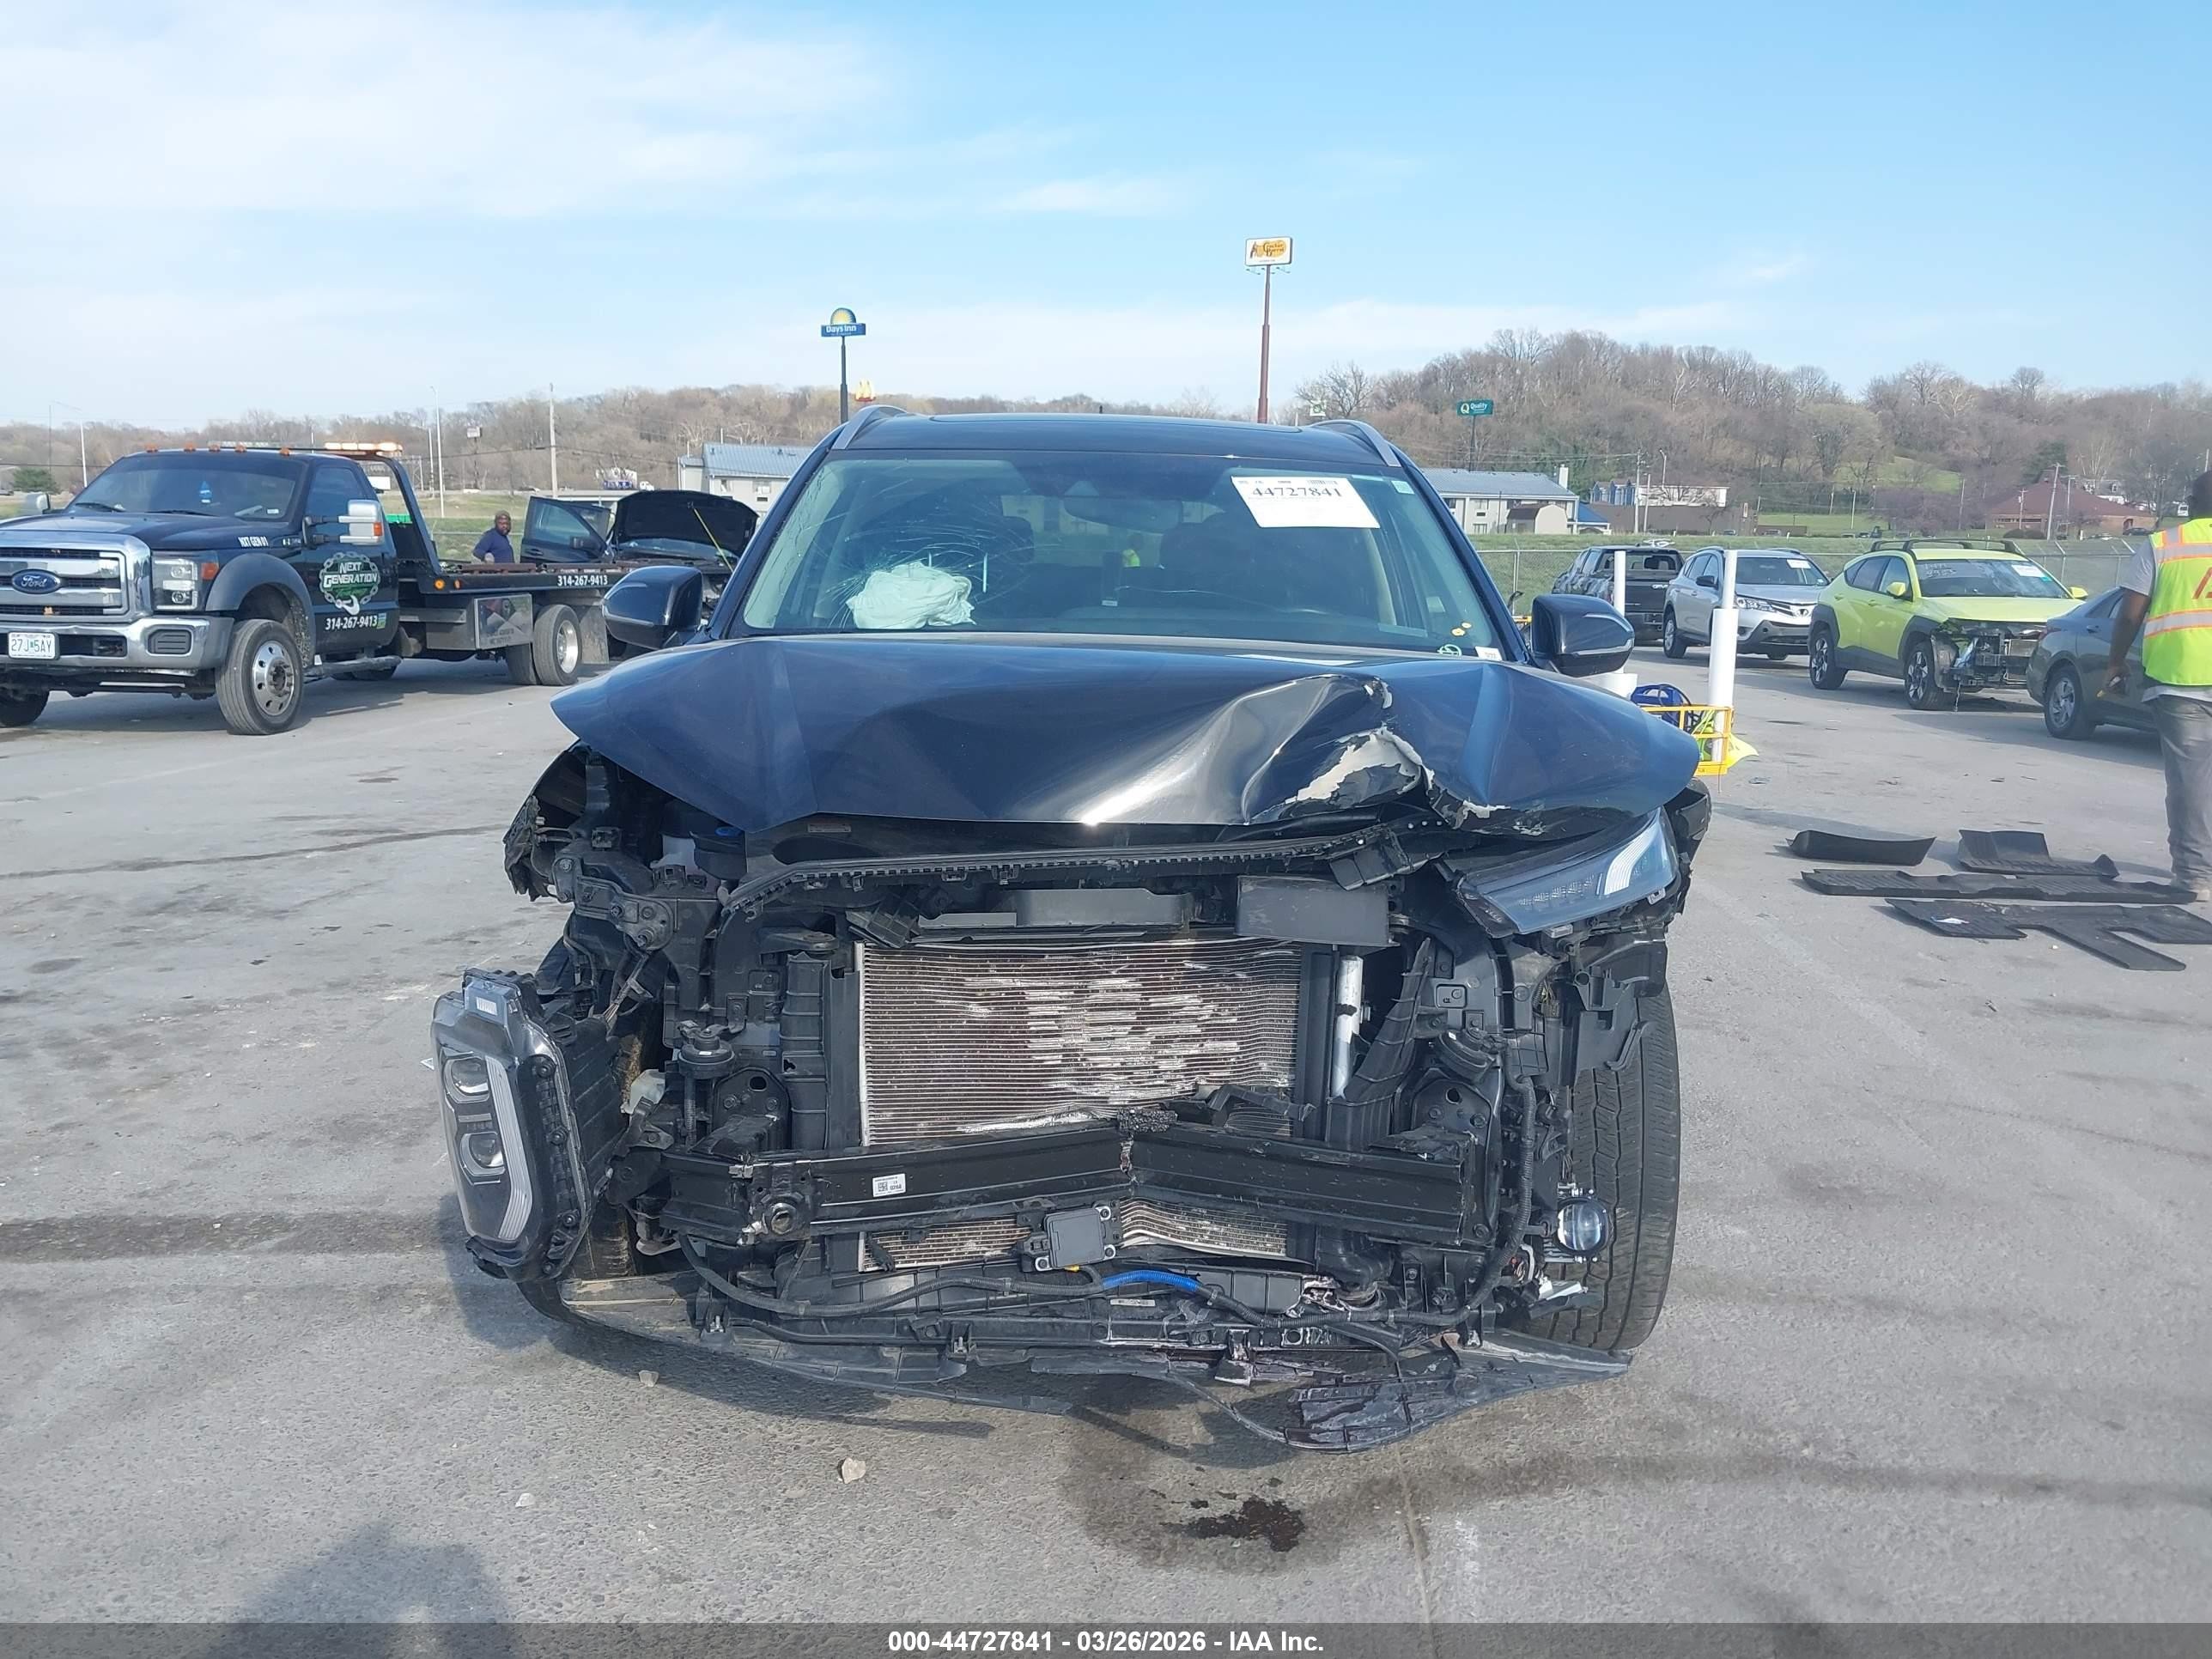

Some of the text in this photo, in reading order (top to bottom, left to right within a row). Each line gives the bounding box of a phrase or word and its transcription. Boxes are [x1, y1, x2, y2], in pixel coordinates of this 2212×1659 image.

[1252, 487, 1342, 497] 44727841
[238, 536, 252, 547] NXT
[21, 575, 48, 587] Ford
[558, 575, 609, 586] 314-267-9413
[325, 615, 378, 630] 314-267-9413
